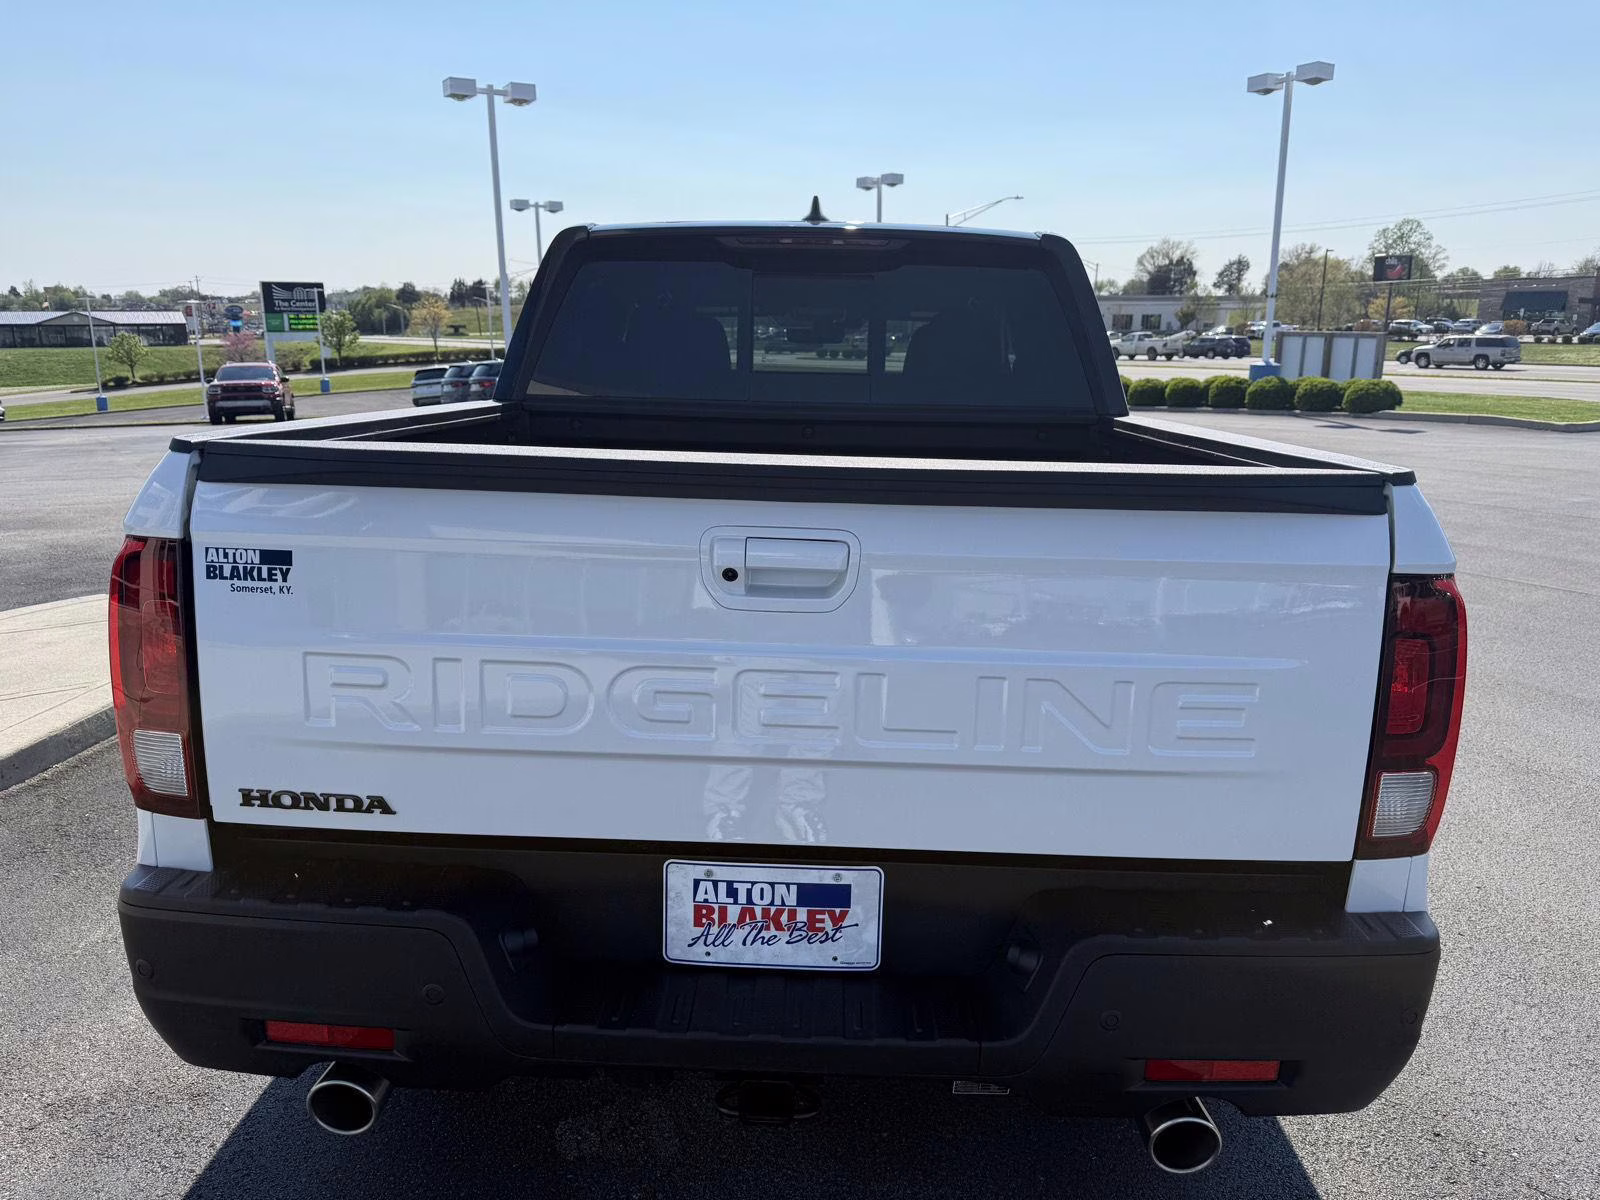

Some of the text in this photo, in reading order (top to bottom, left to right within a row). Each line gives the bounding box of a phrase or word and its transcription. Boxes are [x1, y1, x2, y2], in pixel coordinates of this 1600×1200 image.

[206, 548, 260, 564] ALTON
[206, 564, 291, 582] BLAKLEY
[230, 583, 294, 595] Somerset, KY.
[302, 651, 1260, 758] RIDGELINE
[238, 788, 397, 815] HONDA
[694, 880, 797, 906] ALTON
[693, 904, 850, 933] BLAKLEY
[688, 920, 859, 948] All The Best
